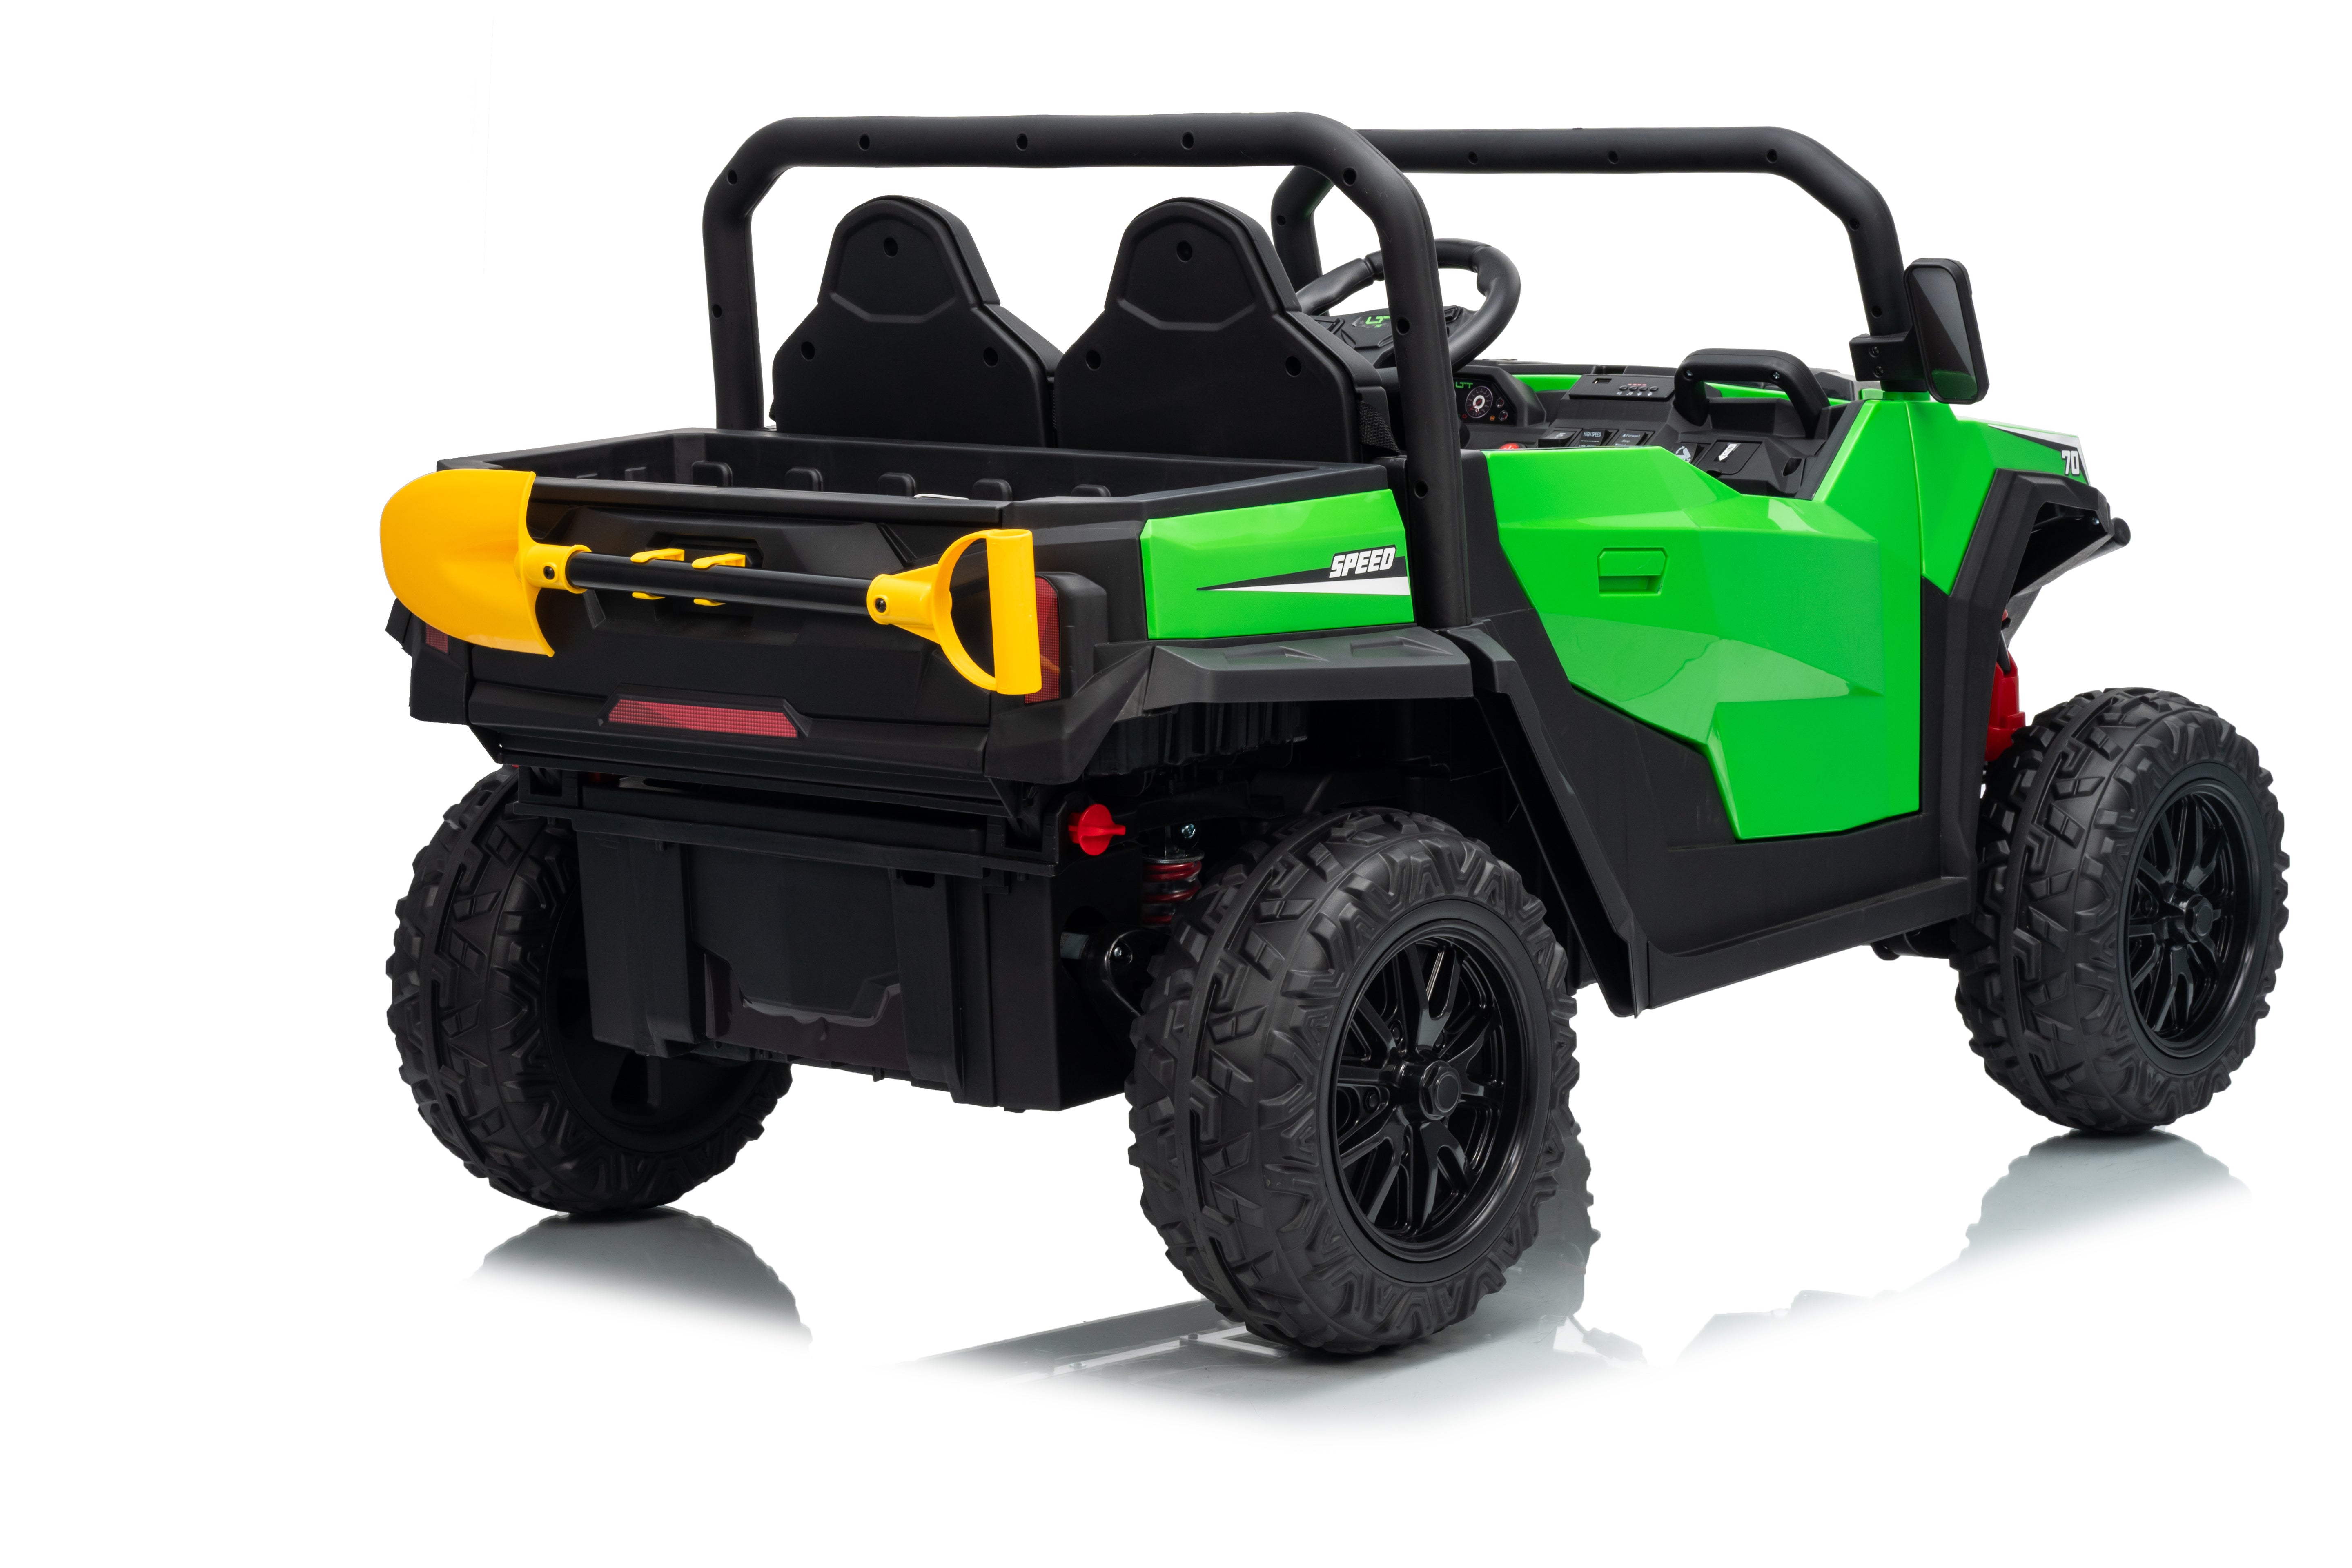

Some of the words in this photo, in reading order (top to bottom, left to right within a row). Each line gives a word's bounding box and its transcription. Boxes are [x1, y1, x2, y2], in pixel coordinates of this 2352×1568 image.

[1721, 445, 1735, 457] INPUT
[2061, 450, 2080, 475] 70
[1329, 547, 1396, 579] SPEED
